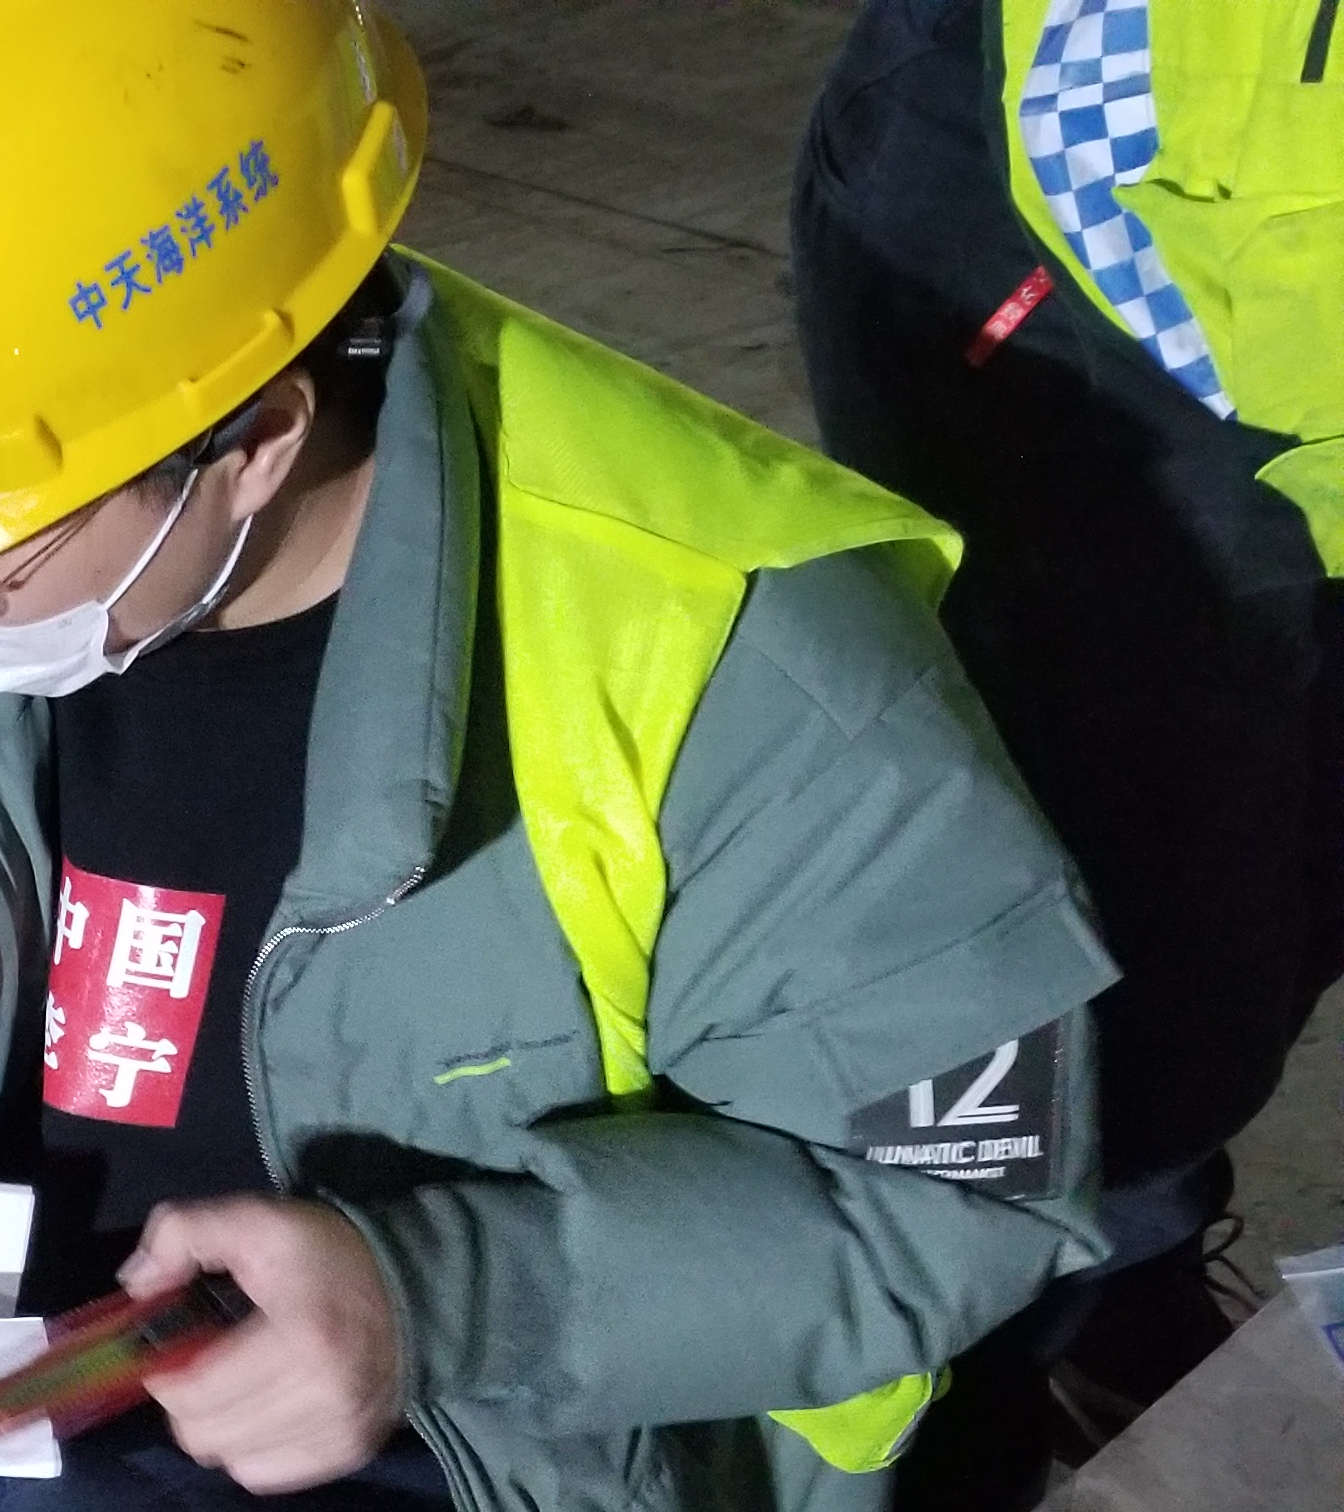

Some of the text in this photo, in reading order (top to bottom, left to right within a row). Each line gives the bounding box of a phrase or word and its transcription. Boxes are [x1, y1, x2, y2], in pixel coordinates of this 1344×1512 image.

[68, 139, 279, 329] 中天海洋系统
